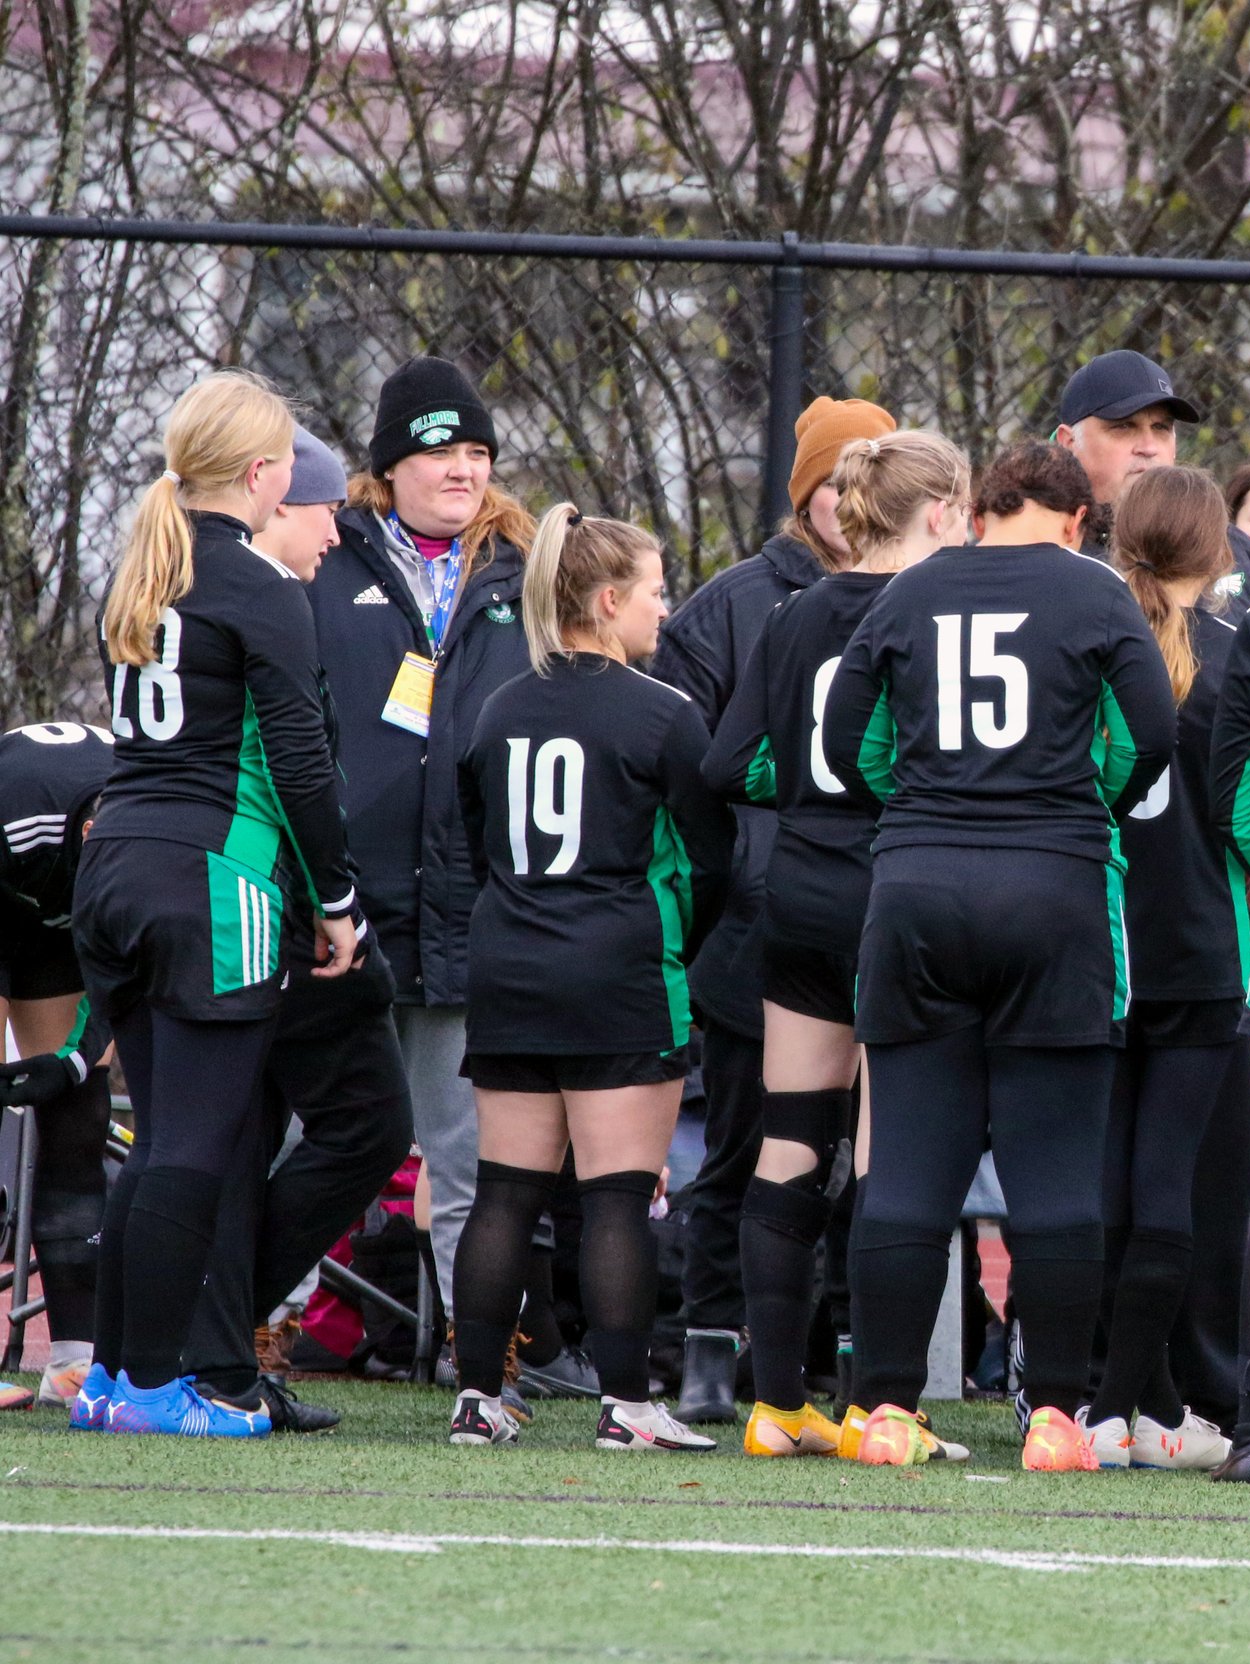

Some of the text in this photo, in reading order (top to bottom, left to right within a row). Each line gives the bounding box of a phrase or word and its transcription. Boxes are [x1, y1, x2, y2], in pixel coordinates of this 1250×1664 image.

[409, 410, 460, 438] FILLMORE
[353, 597, 389, 605] adidas
[932, 612, 1029, 751] 15
[506, 737, 585, 875] 19
